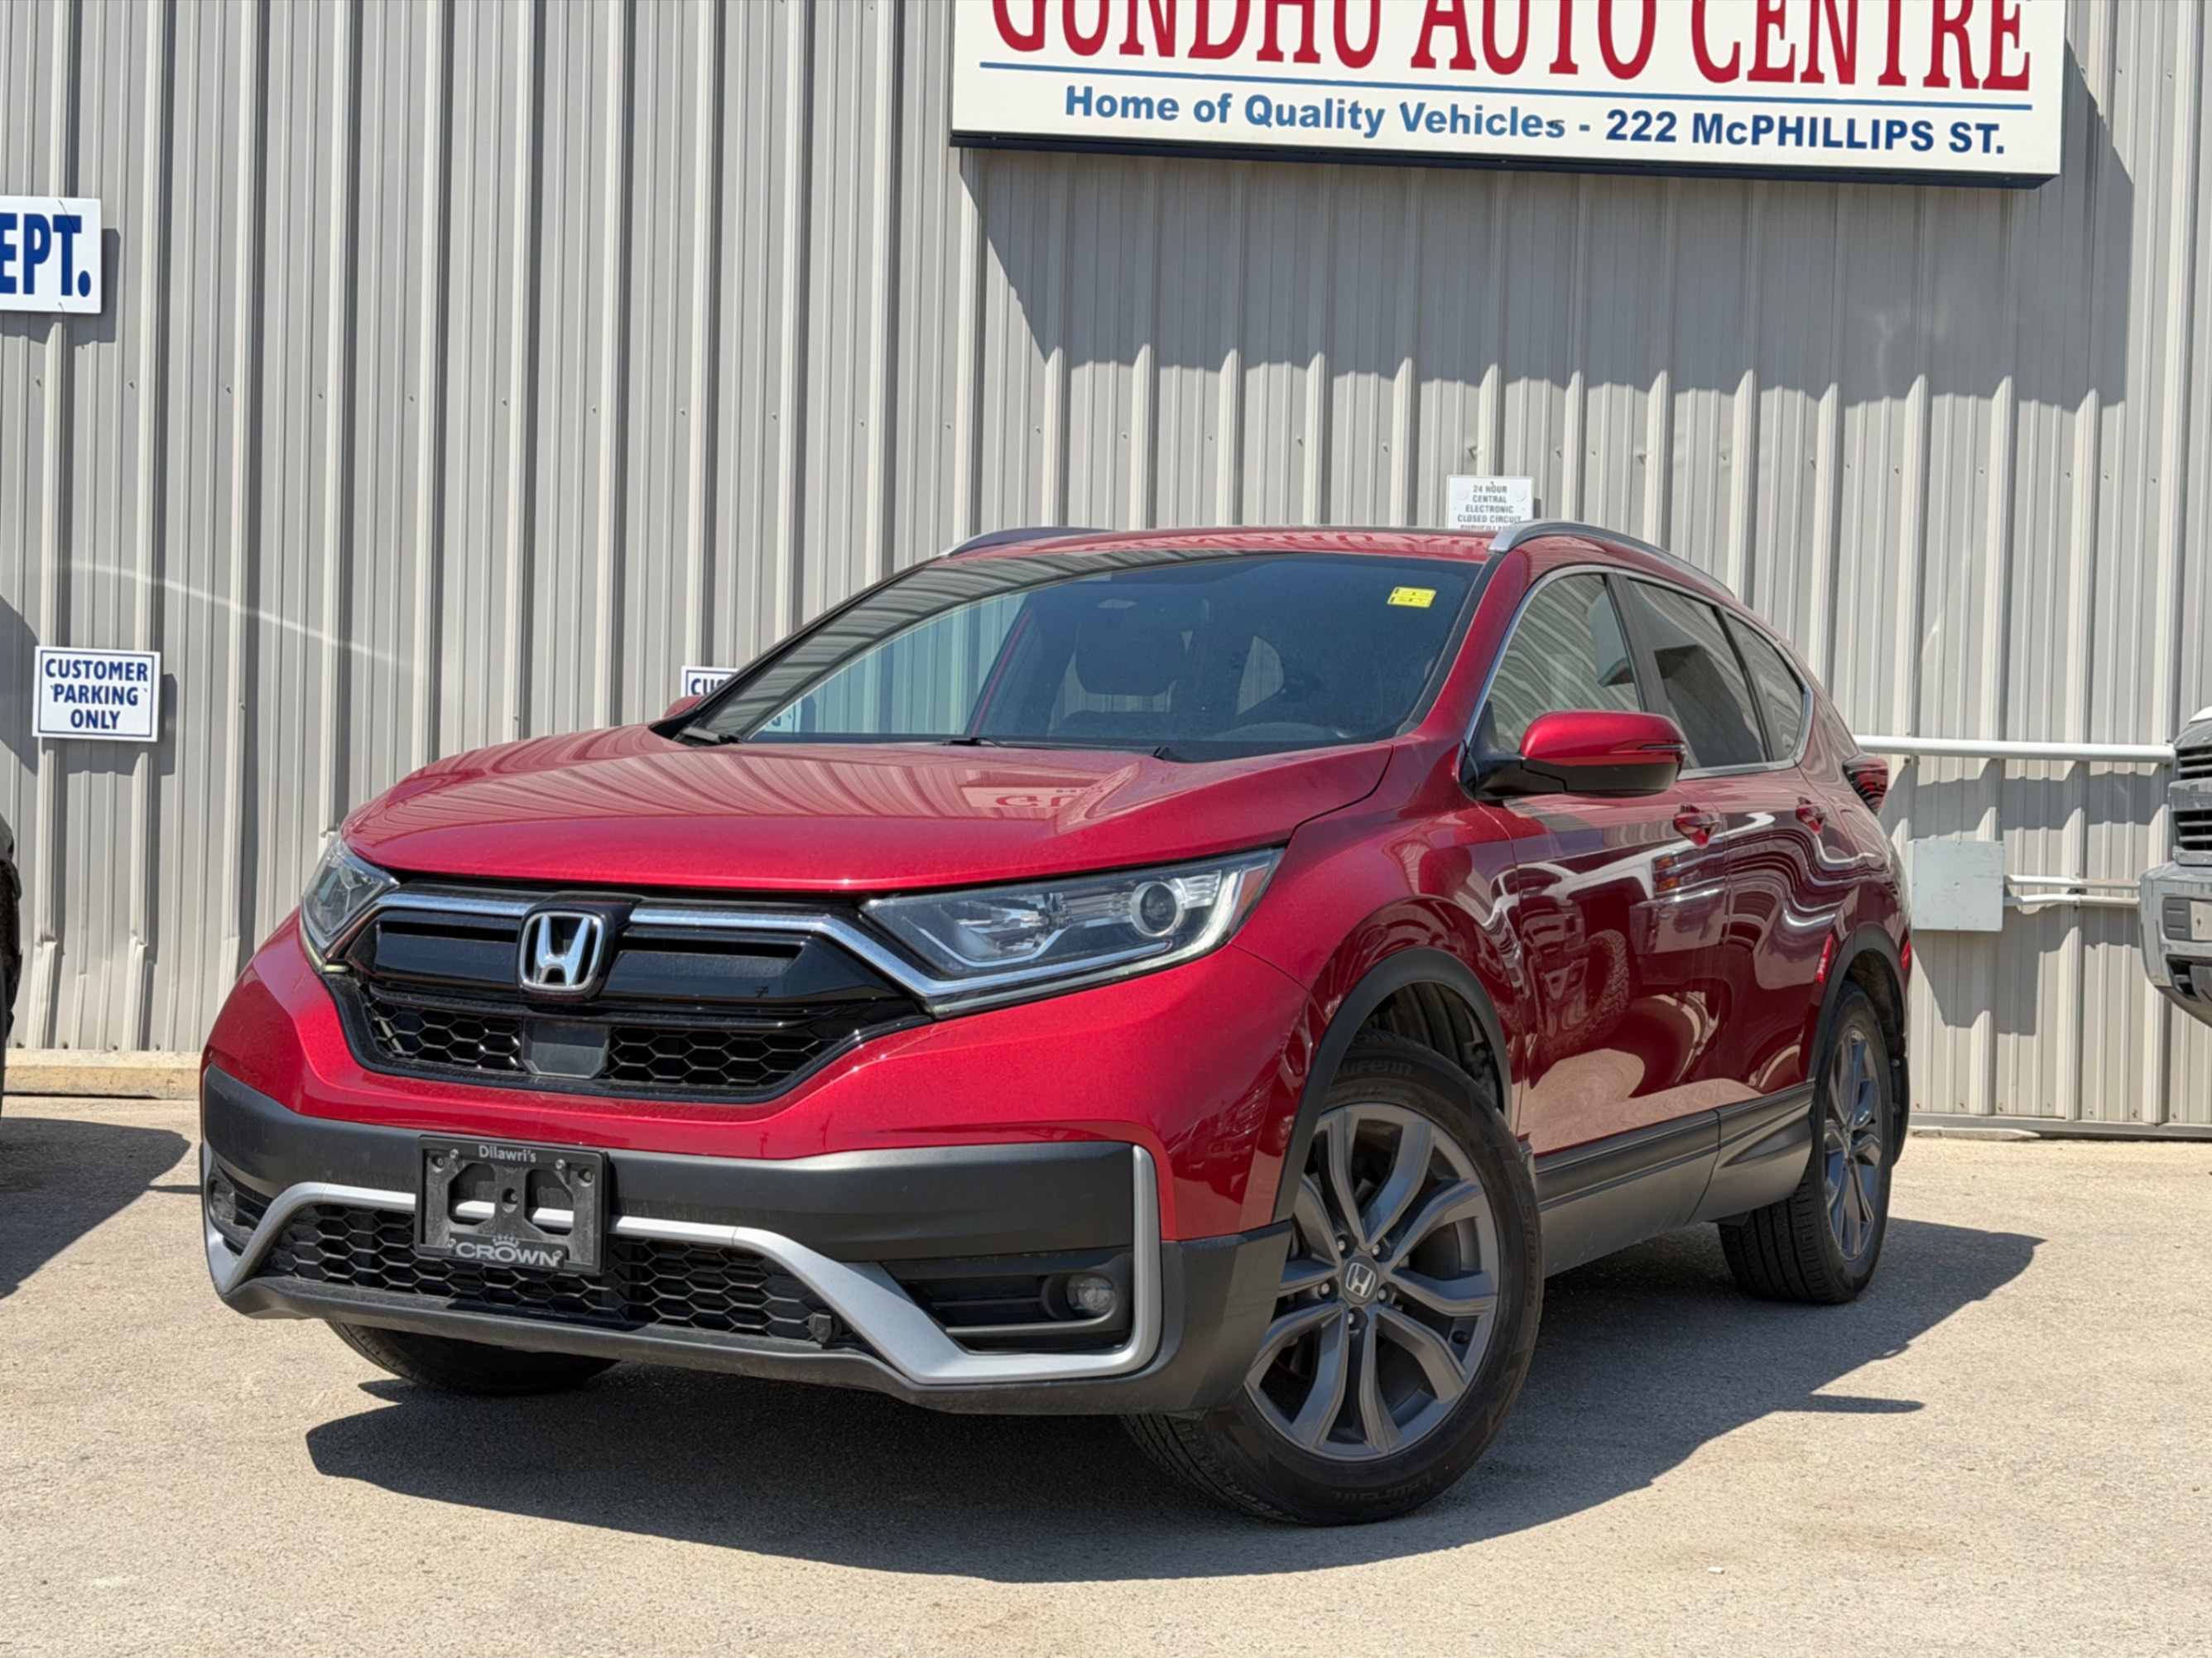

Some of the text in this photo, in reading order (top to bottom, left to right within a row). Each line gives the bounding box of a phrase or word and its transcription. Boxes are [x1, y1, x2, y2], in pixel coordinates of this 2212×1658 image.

[1411, 0, 1657, 80] AUTO
[1690, 0, 2030, 91] CENTRE
[1065, 86, 1179, 121] Home
[1193, 93, 1232, 123] of
[1244, 94, 1385, 138] Quality
[1400, 102, 1565, 138] Vehicles
[1606, 109, 1676, 142] 222
[1692, 113, 1934, 151] McPHILLIPS
[1950, 121, 2004, 154] ST.
[1473, 485, 1508, 493] 24 HOUR
[1473, 495, 1508, 503] CENTRAL
[1457, 514, 1522, 523] CLOSED CIRCUIT
[1465, 504, 1514, 513] ELECTRONIC
[45, 658, 148, 682] CUSTOMER
[53, 683, 138, 706] PARKING
[70, 709, 121, 729] ONLY
[478, 1146, 537, 1163] Dilawri's
[456, 1242, 560, 1267] CROWN
